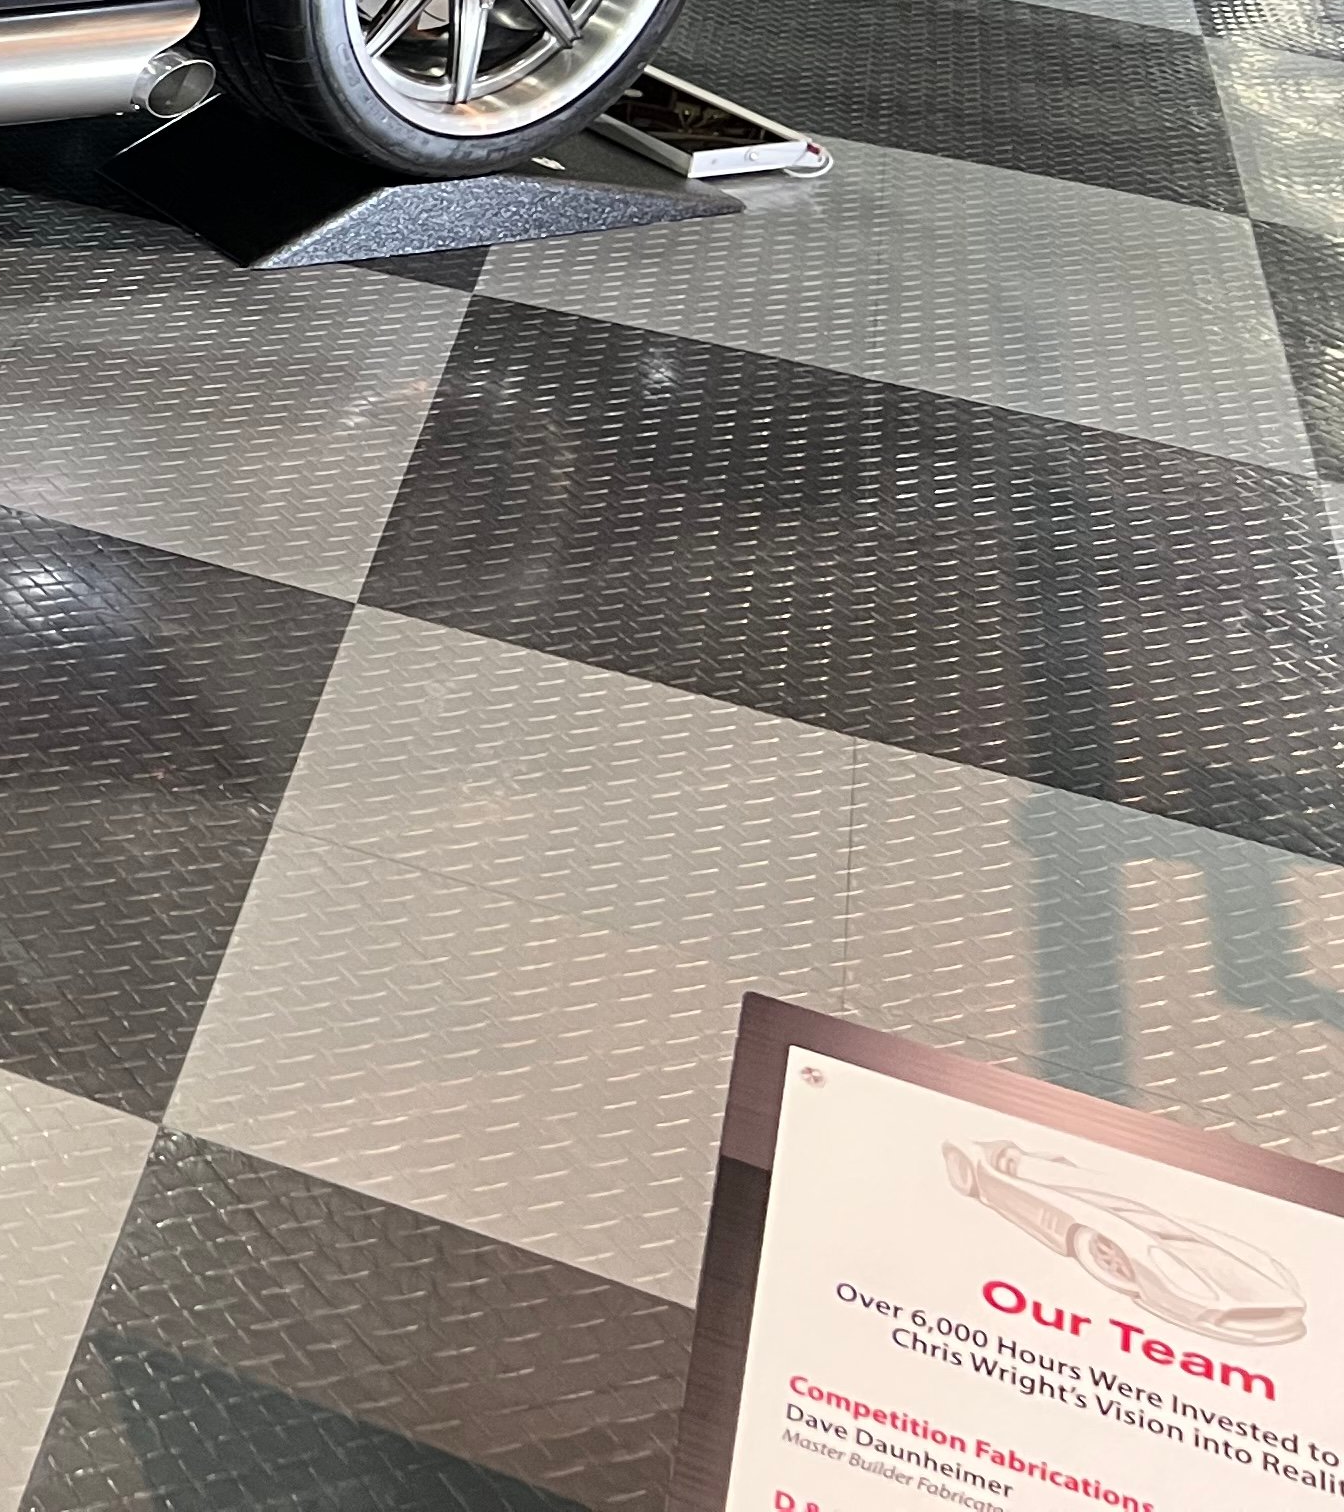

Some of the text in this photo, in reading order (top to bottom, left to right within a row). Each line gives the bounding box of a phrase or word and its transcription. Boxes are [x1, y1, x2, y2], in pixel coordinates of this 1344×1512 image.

[836, 1283, 1339, 1467] Over 6,000 Hours Were Invested to
[982, 1281, 1275, 1401] Our Team
[789, 1375, 967, 1453] Competition
[892, 1328, 963, 1366] Chris
[969, 1352, 1088, 1409] Wright's
[1095, 1394, 1183, 1442] Vision
[1193, 1428, 1252, 1464] into
[781, 1429, 847, 1462] Master
[848, 1452, 914, 1486] Builder
[786, 1403, 1014, 1498] Dave Daunheimer
